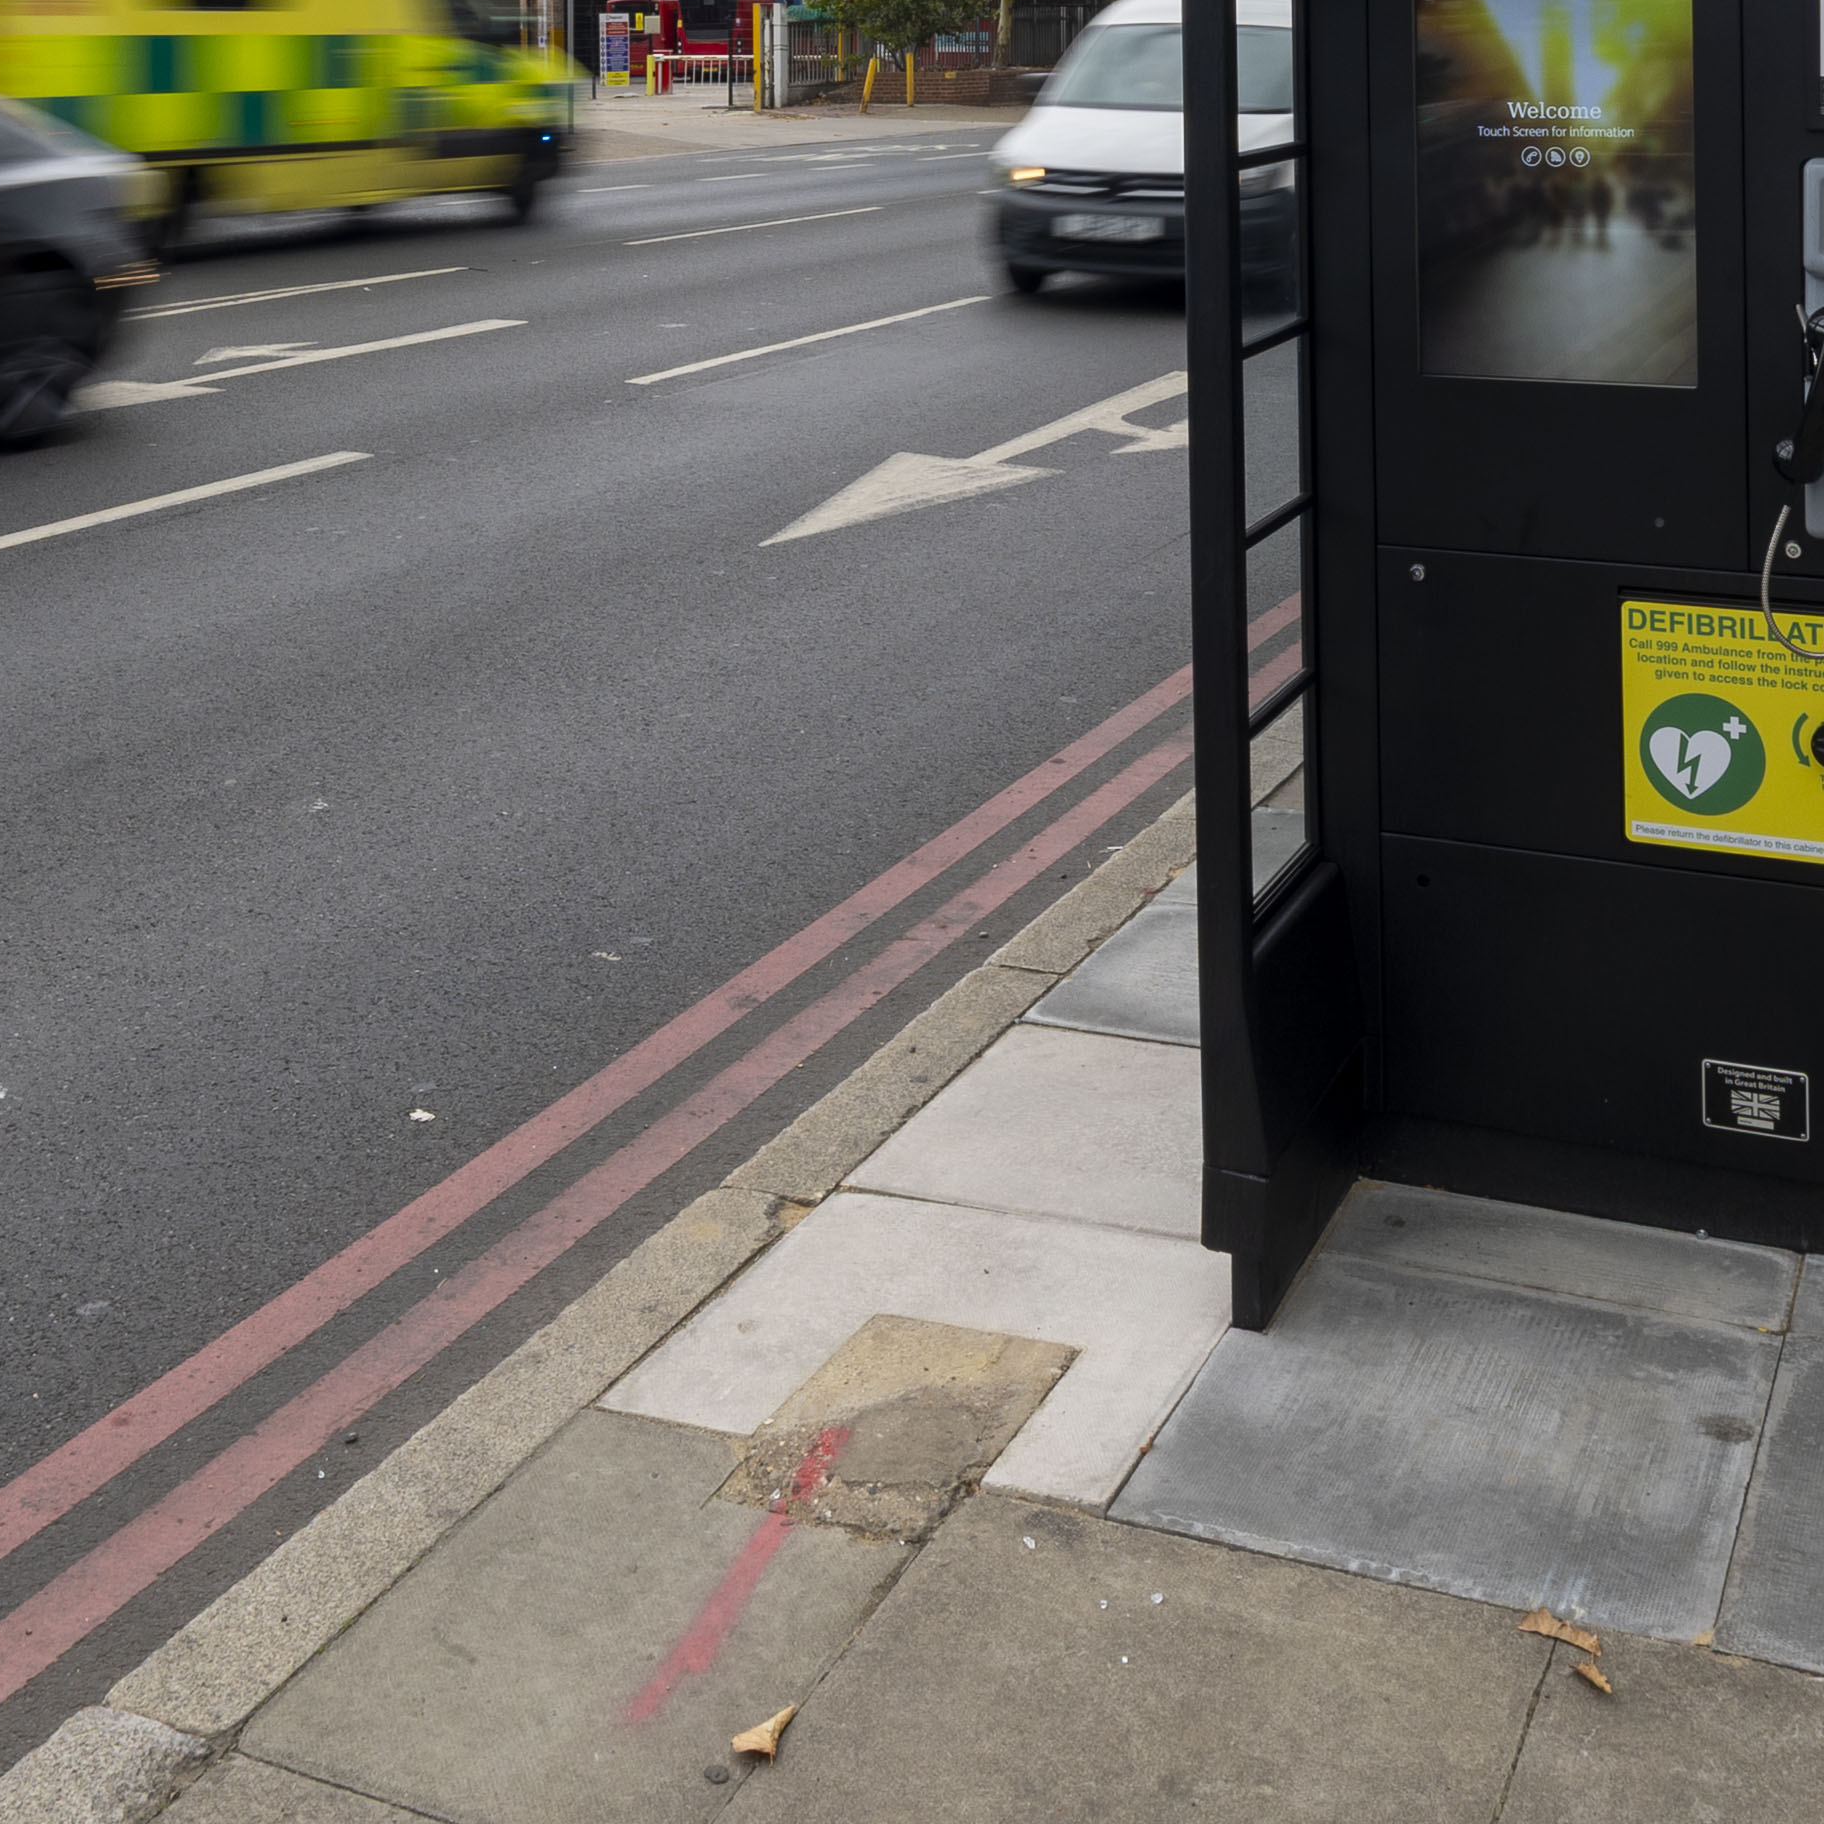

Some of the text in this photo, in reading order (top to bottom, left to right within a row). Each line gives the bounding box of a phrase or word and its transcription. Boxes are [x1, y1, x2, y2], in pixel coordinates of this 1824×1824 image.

[1507, 101, 1602, 120] Welcome
[1478, 126, 1635, 138] Touch Screen for information
[1629, 638, 1653, 650] Call
[1656, 640, 1678, 652] 999
[1682, 642, 1753, 659] Ambulance
[1757, 649, 1787, 662] from
[1637, 652, 1688, 667] location
[1691, 656, 1714, 669] and
[1718, 659, 1757, 674] follow
[1760, 662, 1781, 675] the
[1655, 668, 1689, 681] given
[1693, 671, 1705, 682] to
[1709, 675, 1754, 687] access
[1757, 676, 1777, 688] the
[1781, 678, 1808, 692] lock
[1635, 824, 1666, 837] Please
[1668, 828, 1694, 840] return
[1696, 831, 1711, 842] the
[1712, 833, 1762, 849] defibrillator
[1764, 839, 1773, 849] to
[1775, 839, 1792, 851] this
[1717, 1066, 1793, 1085] Designed and built
[1725, 1077, 1786, 1093] in Great Britain
